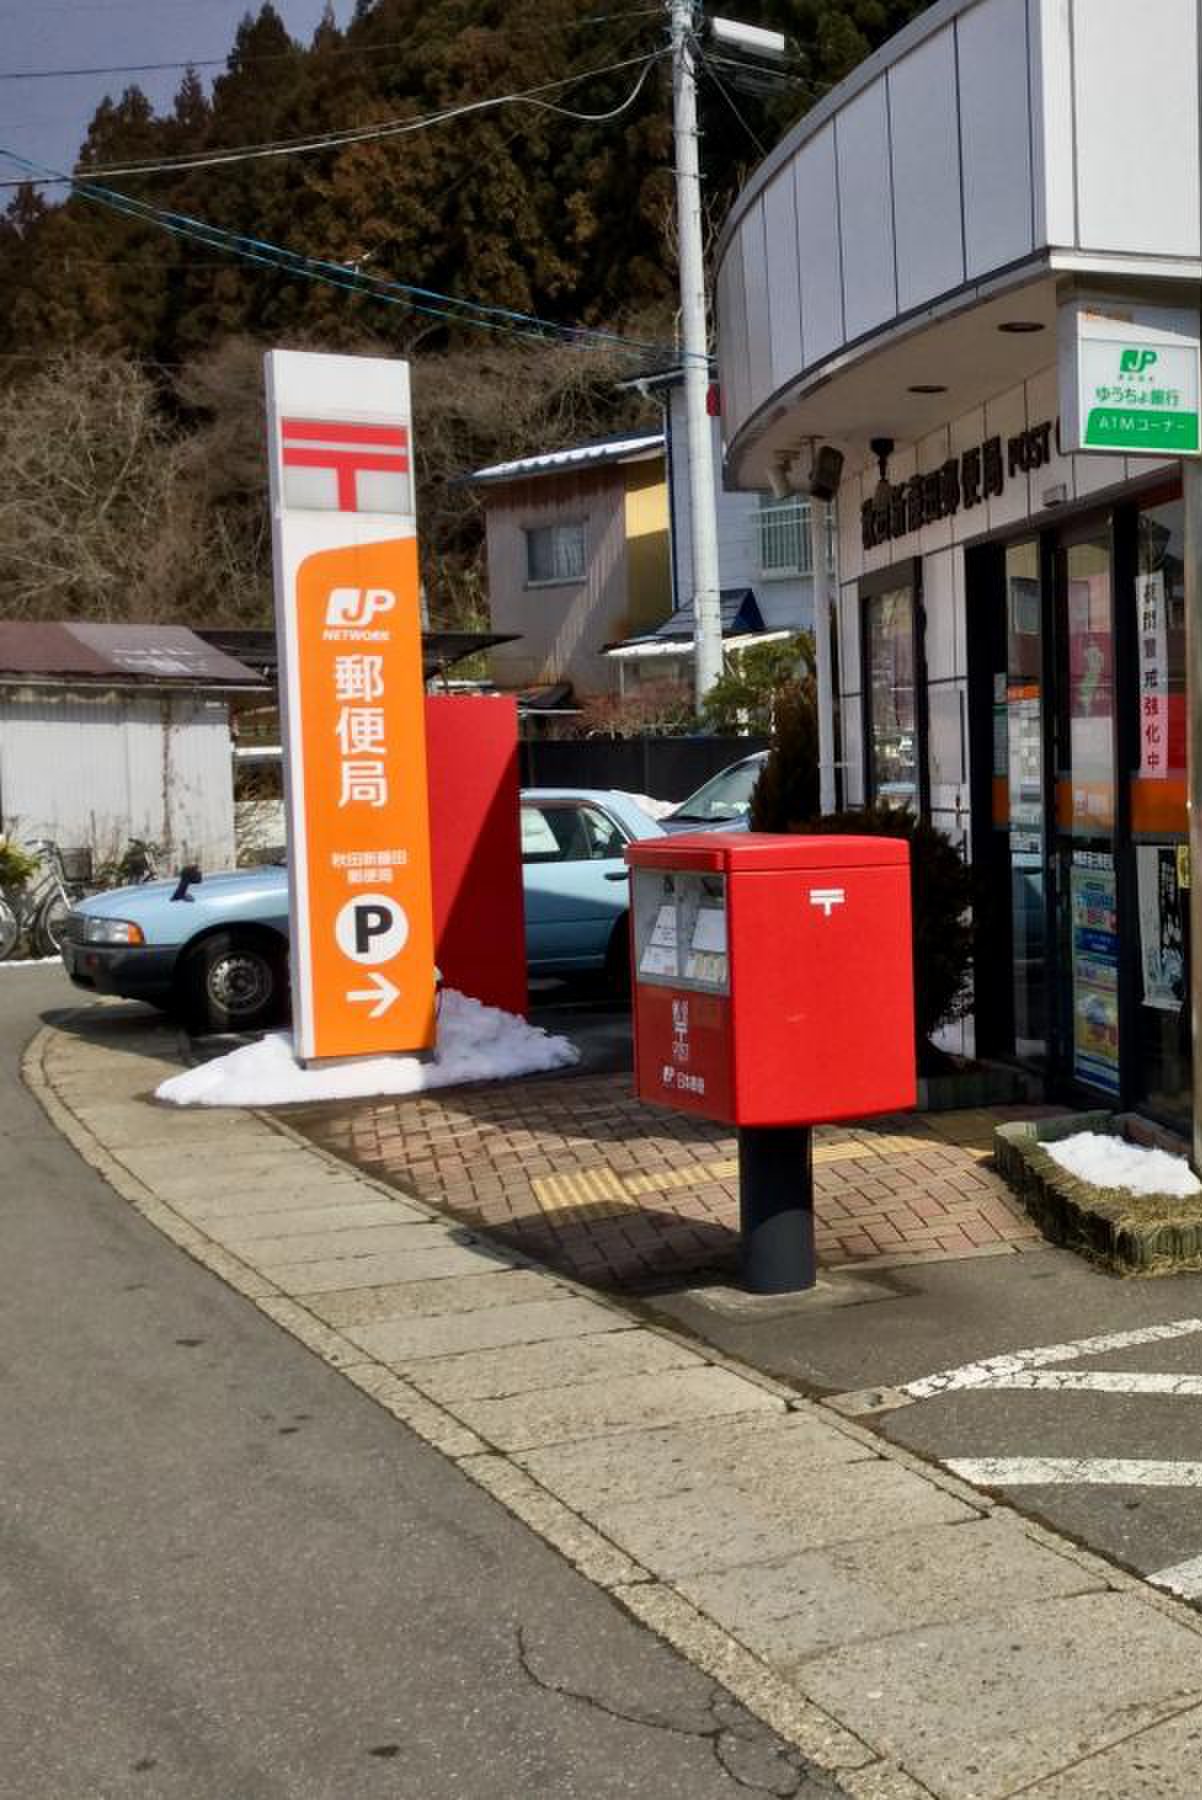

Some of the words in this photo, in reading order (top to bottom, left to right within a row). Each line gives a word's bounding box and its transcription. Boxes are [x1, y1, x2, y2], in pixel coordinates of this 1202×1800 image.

[1095, 385, 1181, 406] ゆうちょ銀行
[1098, 416, 1185, 433] ATMコーナー
[1007, 421, 1052, 478] POST
[322, 628, 391, 641] NETWORK
[332, 654, 388, 808] 郵便局
[354, 905, 394, 954] P
